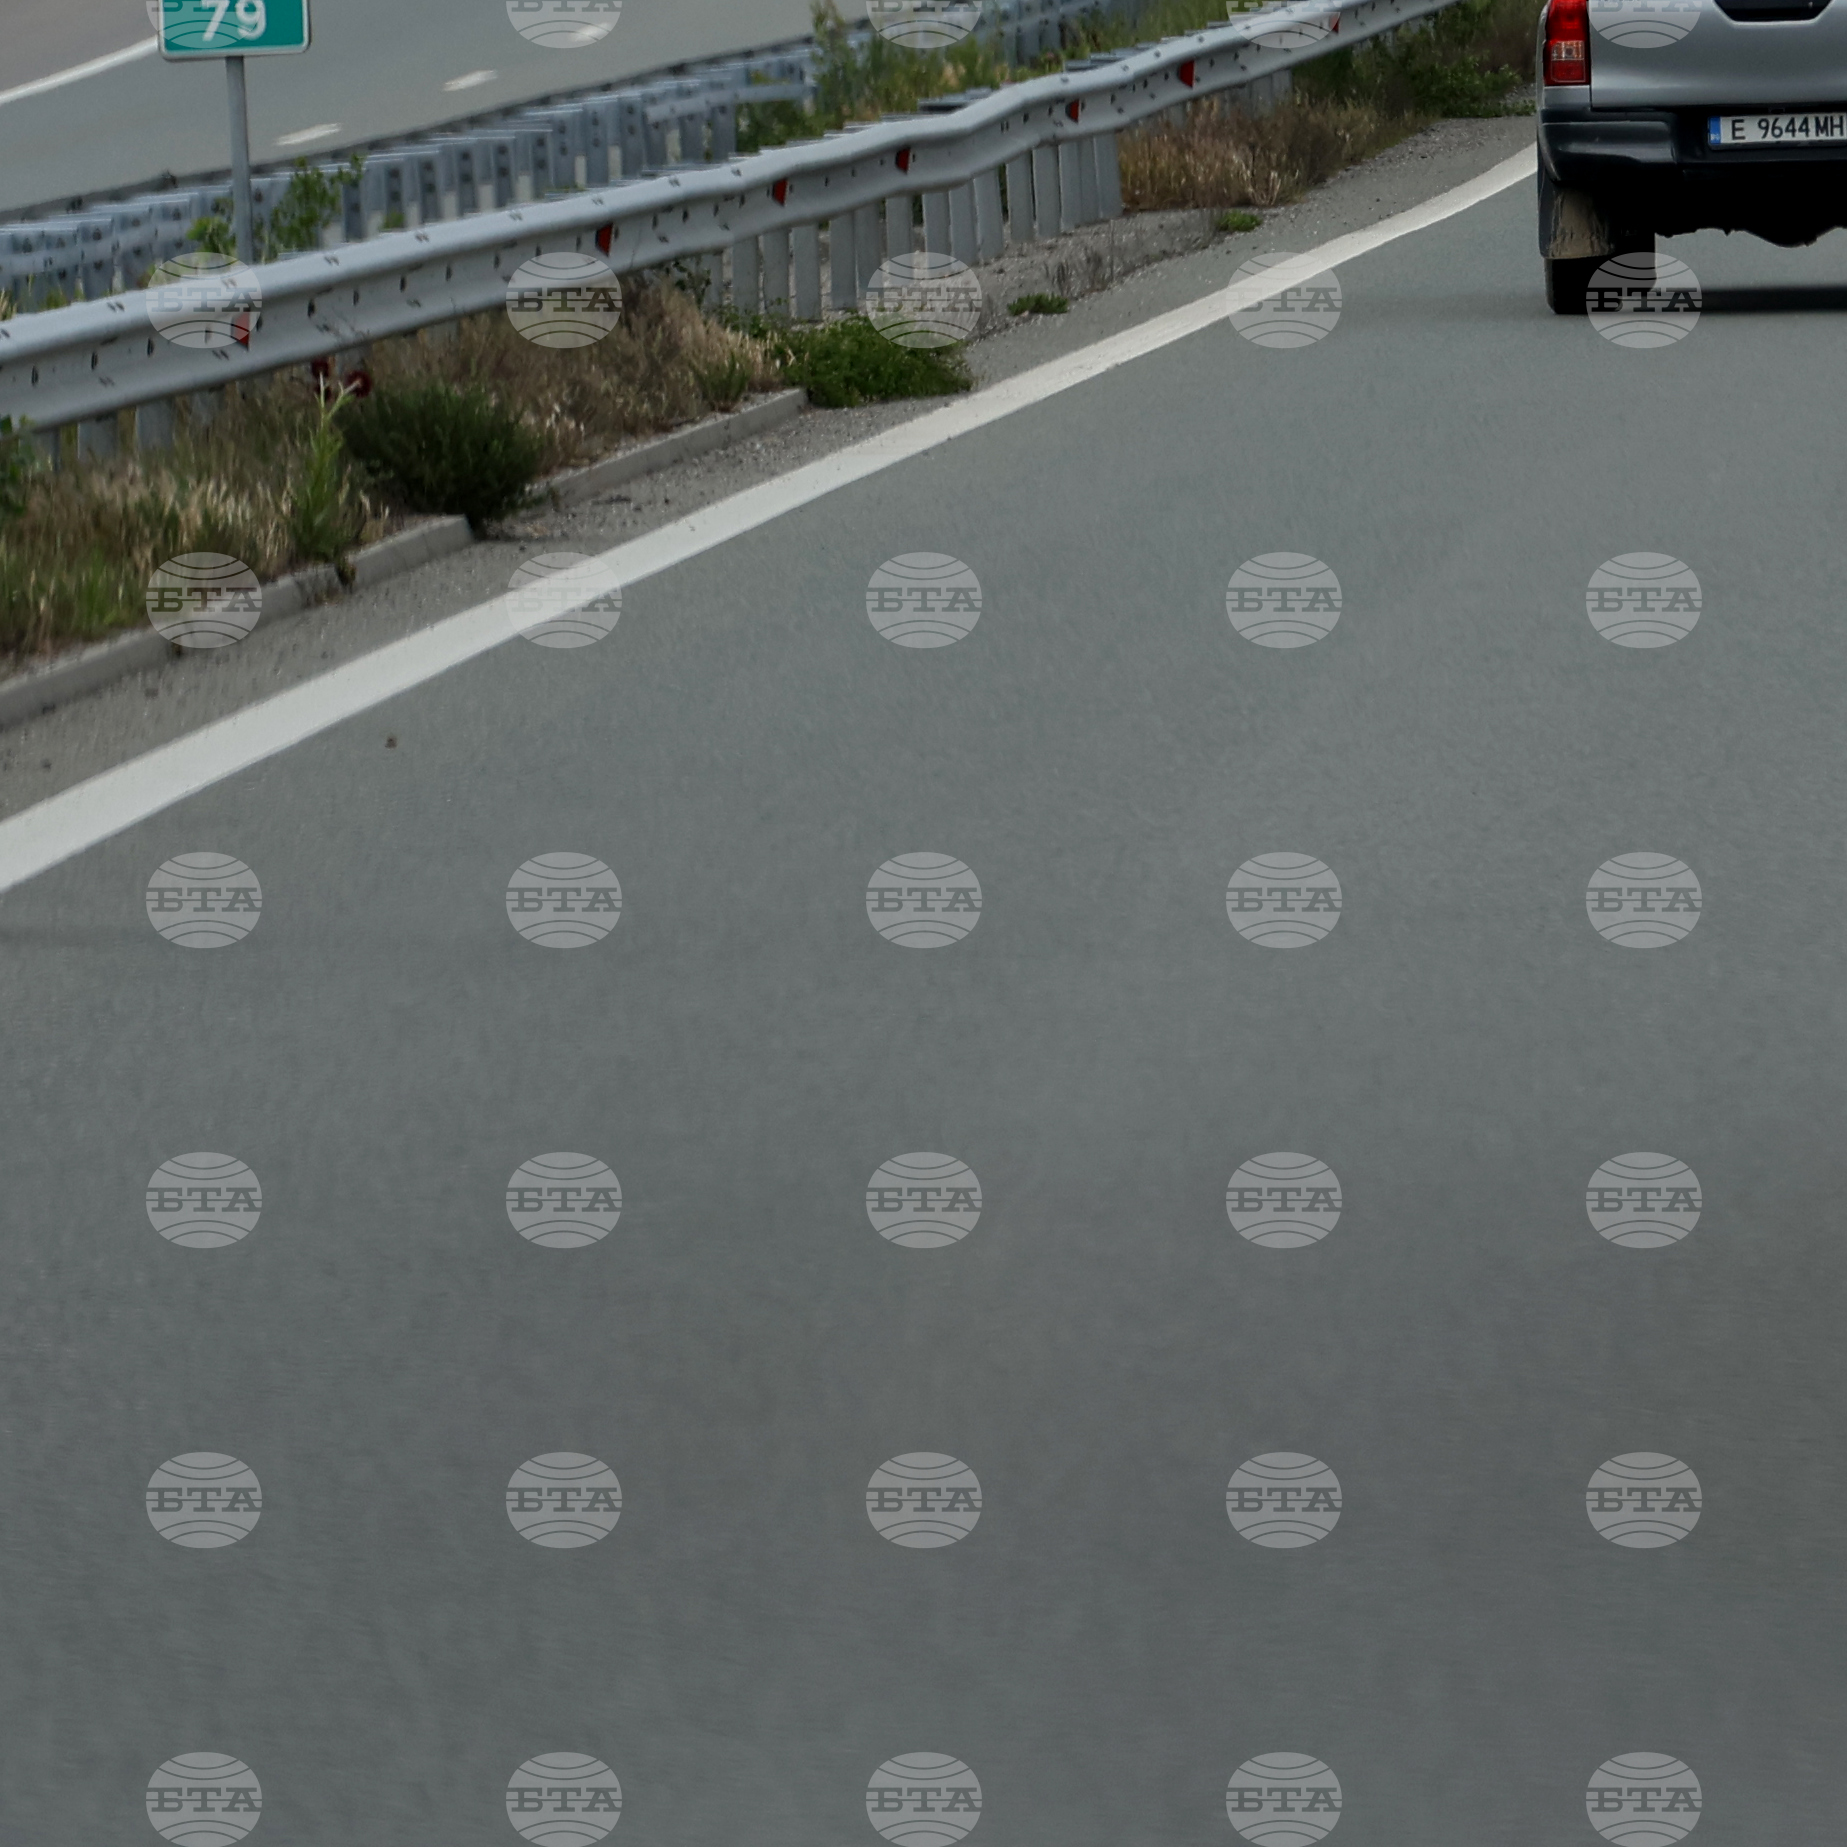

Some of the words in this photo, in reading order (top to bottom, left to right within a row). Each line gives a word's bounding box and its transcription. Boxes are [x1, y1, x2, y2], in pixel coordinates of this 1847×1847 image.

[1731, 118, 1746, 140] E
[1757, 116, 1810, 139] 9644
[1814, 115, 1844, 137] MH
